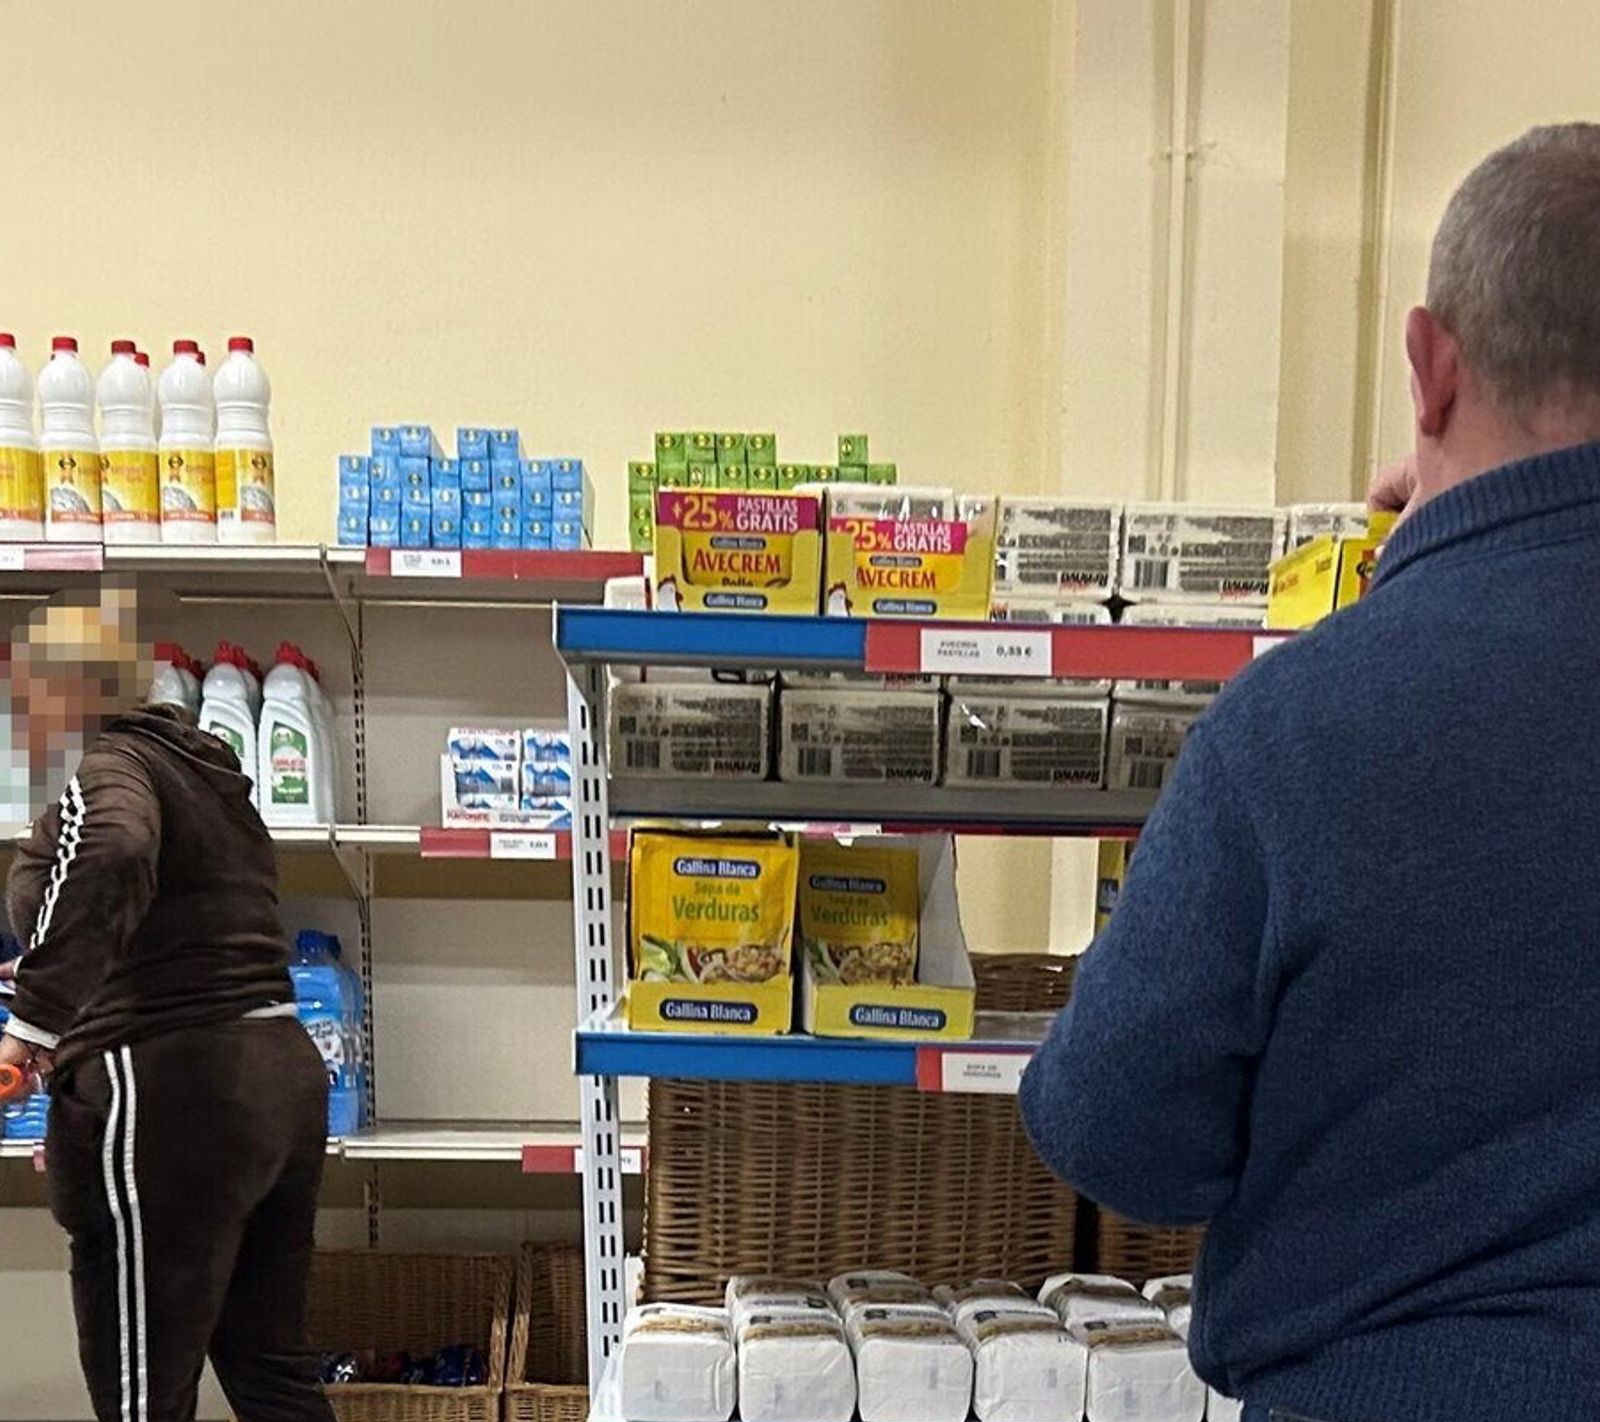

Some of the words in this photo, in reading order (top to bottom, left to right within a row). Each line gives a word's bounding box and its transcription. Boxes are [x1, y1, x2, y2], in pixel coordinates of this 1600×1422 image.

[737, 497, 798, 513] PASTILLAS
[736, 512, 798, 532] GRATIS
[894, 523, 951, 537] PASTILLAS
[894, 535, 952, 553] GRATIS
[692, 549, 781, 574] AVECREM
[677, 859, 716, 875] Gallina
[718, 861, 756, 877] Blanca
[672, 896, 760, 921] Verduras
[811, 904, 888, 926] Verduras
[665, 1001, 708, 1018] Gallina
[710, 1004, 751, 1021] Blanca
[855, 1007, 896, 1025] Gallina
[899, 1010, 939, 1028] Blanca
